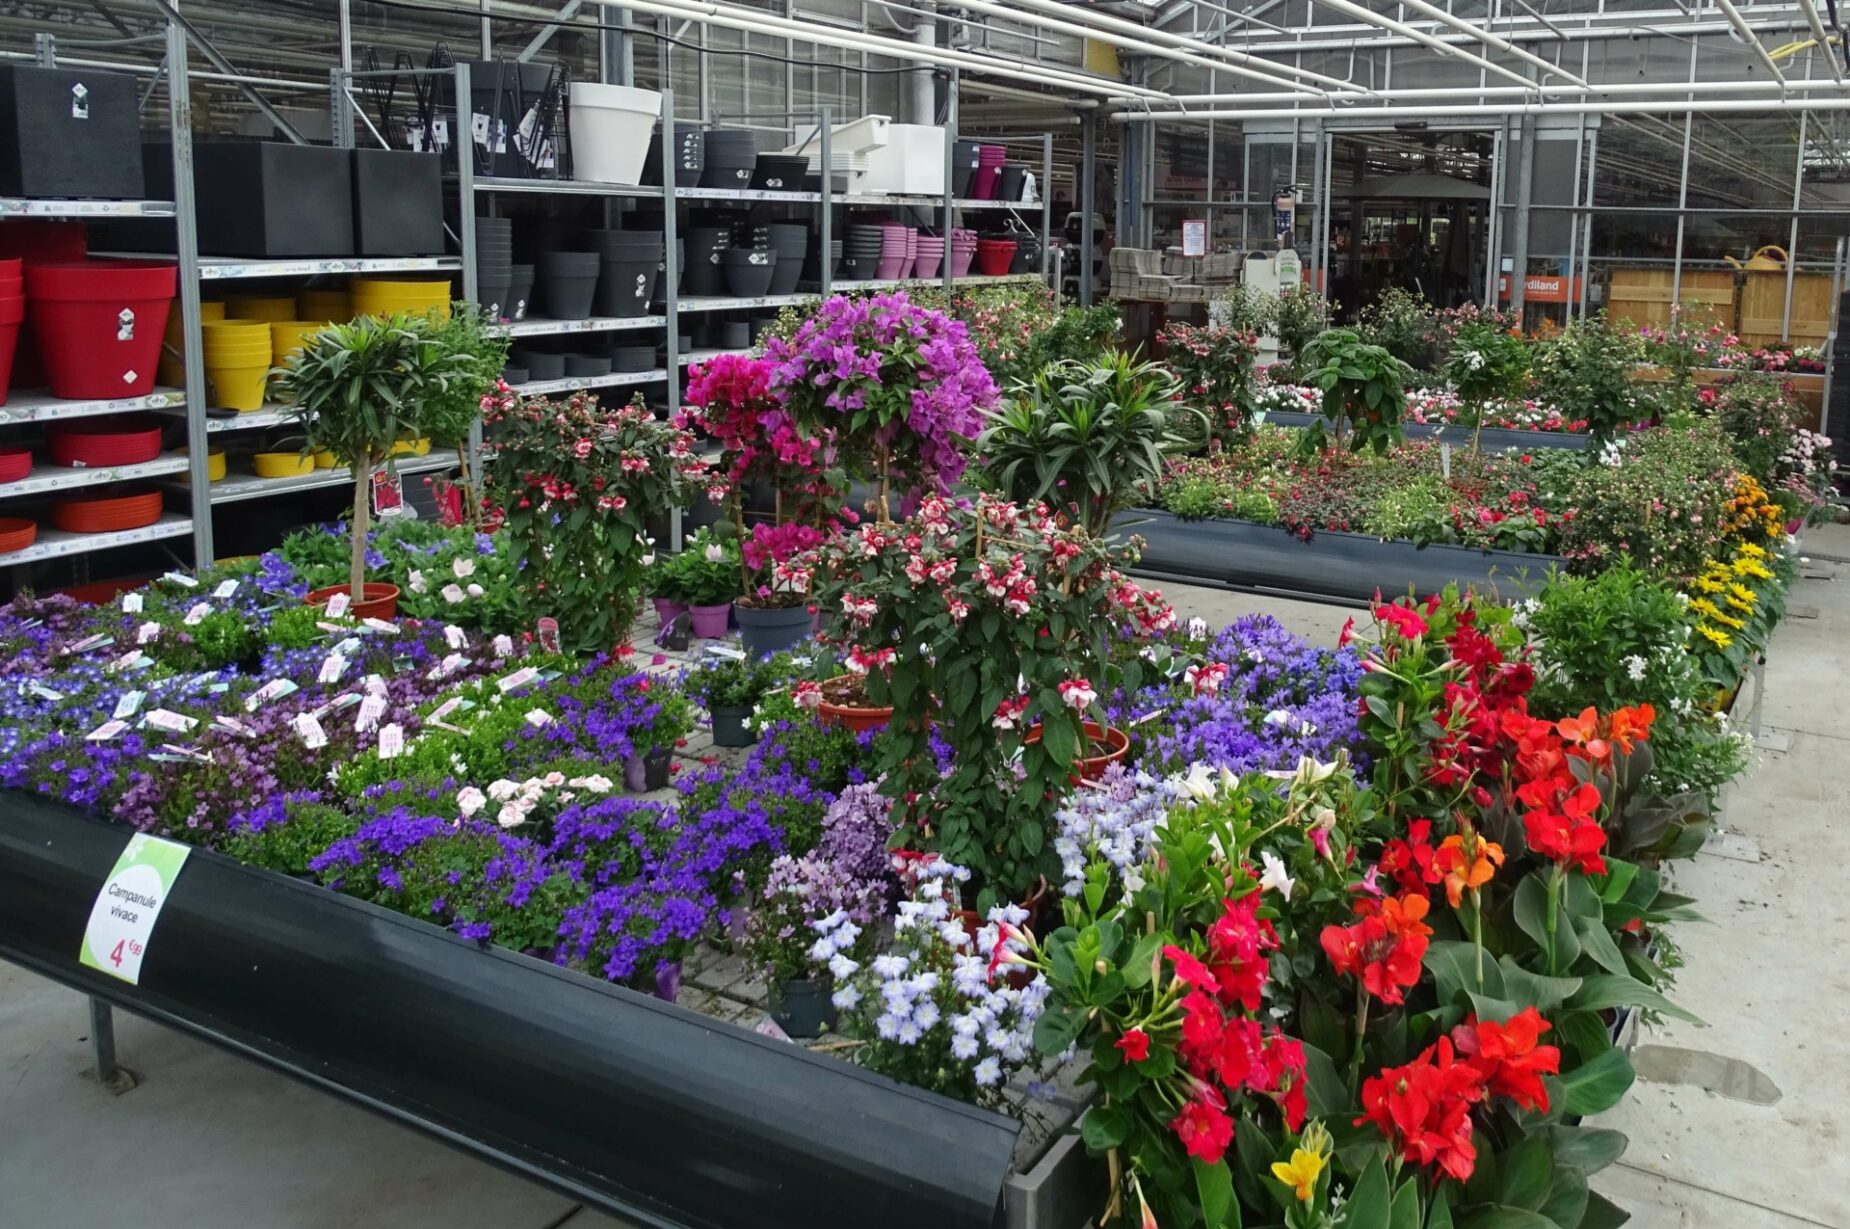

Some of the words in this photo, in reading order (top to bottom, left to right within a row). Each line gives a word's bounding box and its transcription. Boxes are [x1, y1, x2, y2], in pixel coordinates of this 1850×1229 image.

[1524, 280, 1559, 290] rdiland
[94, 470, 110, 480] elho
[108, 883, 157, 908] Campanule
[111, 905, 138, 923] vivace
[110, 938, 126, 968] 4
